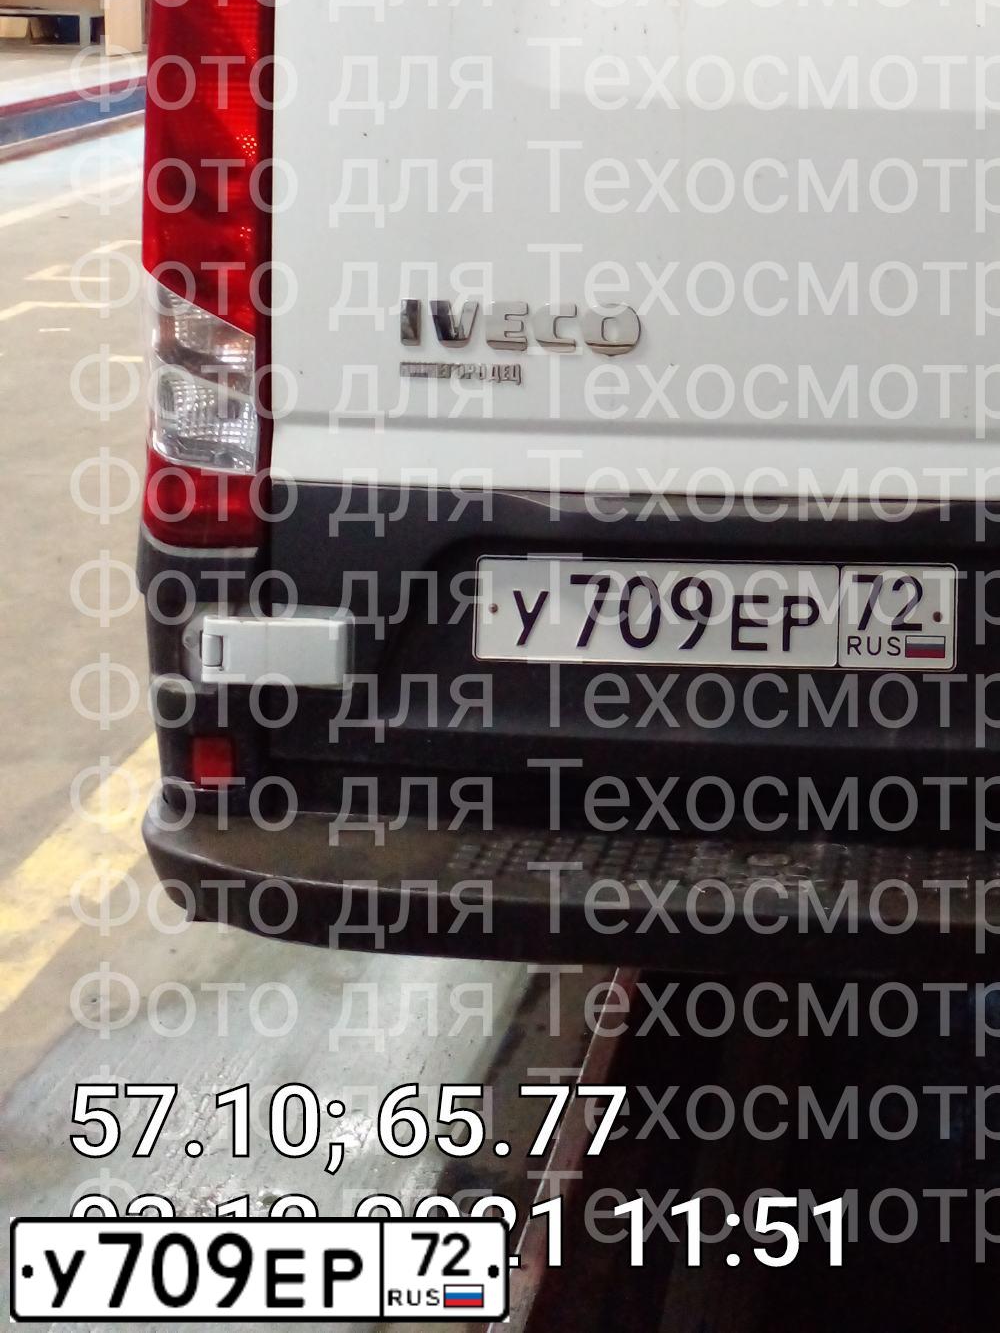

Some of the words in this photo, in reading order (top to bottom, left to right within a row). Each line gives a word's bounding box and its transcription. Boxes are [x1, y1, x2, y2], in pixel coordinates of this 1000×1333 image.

[400, 299, 642, 357] IVECO
[851, 574, 923, 631] 72
[846, 635, 901, 656] RUS
